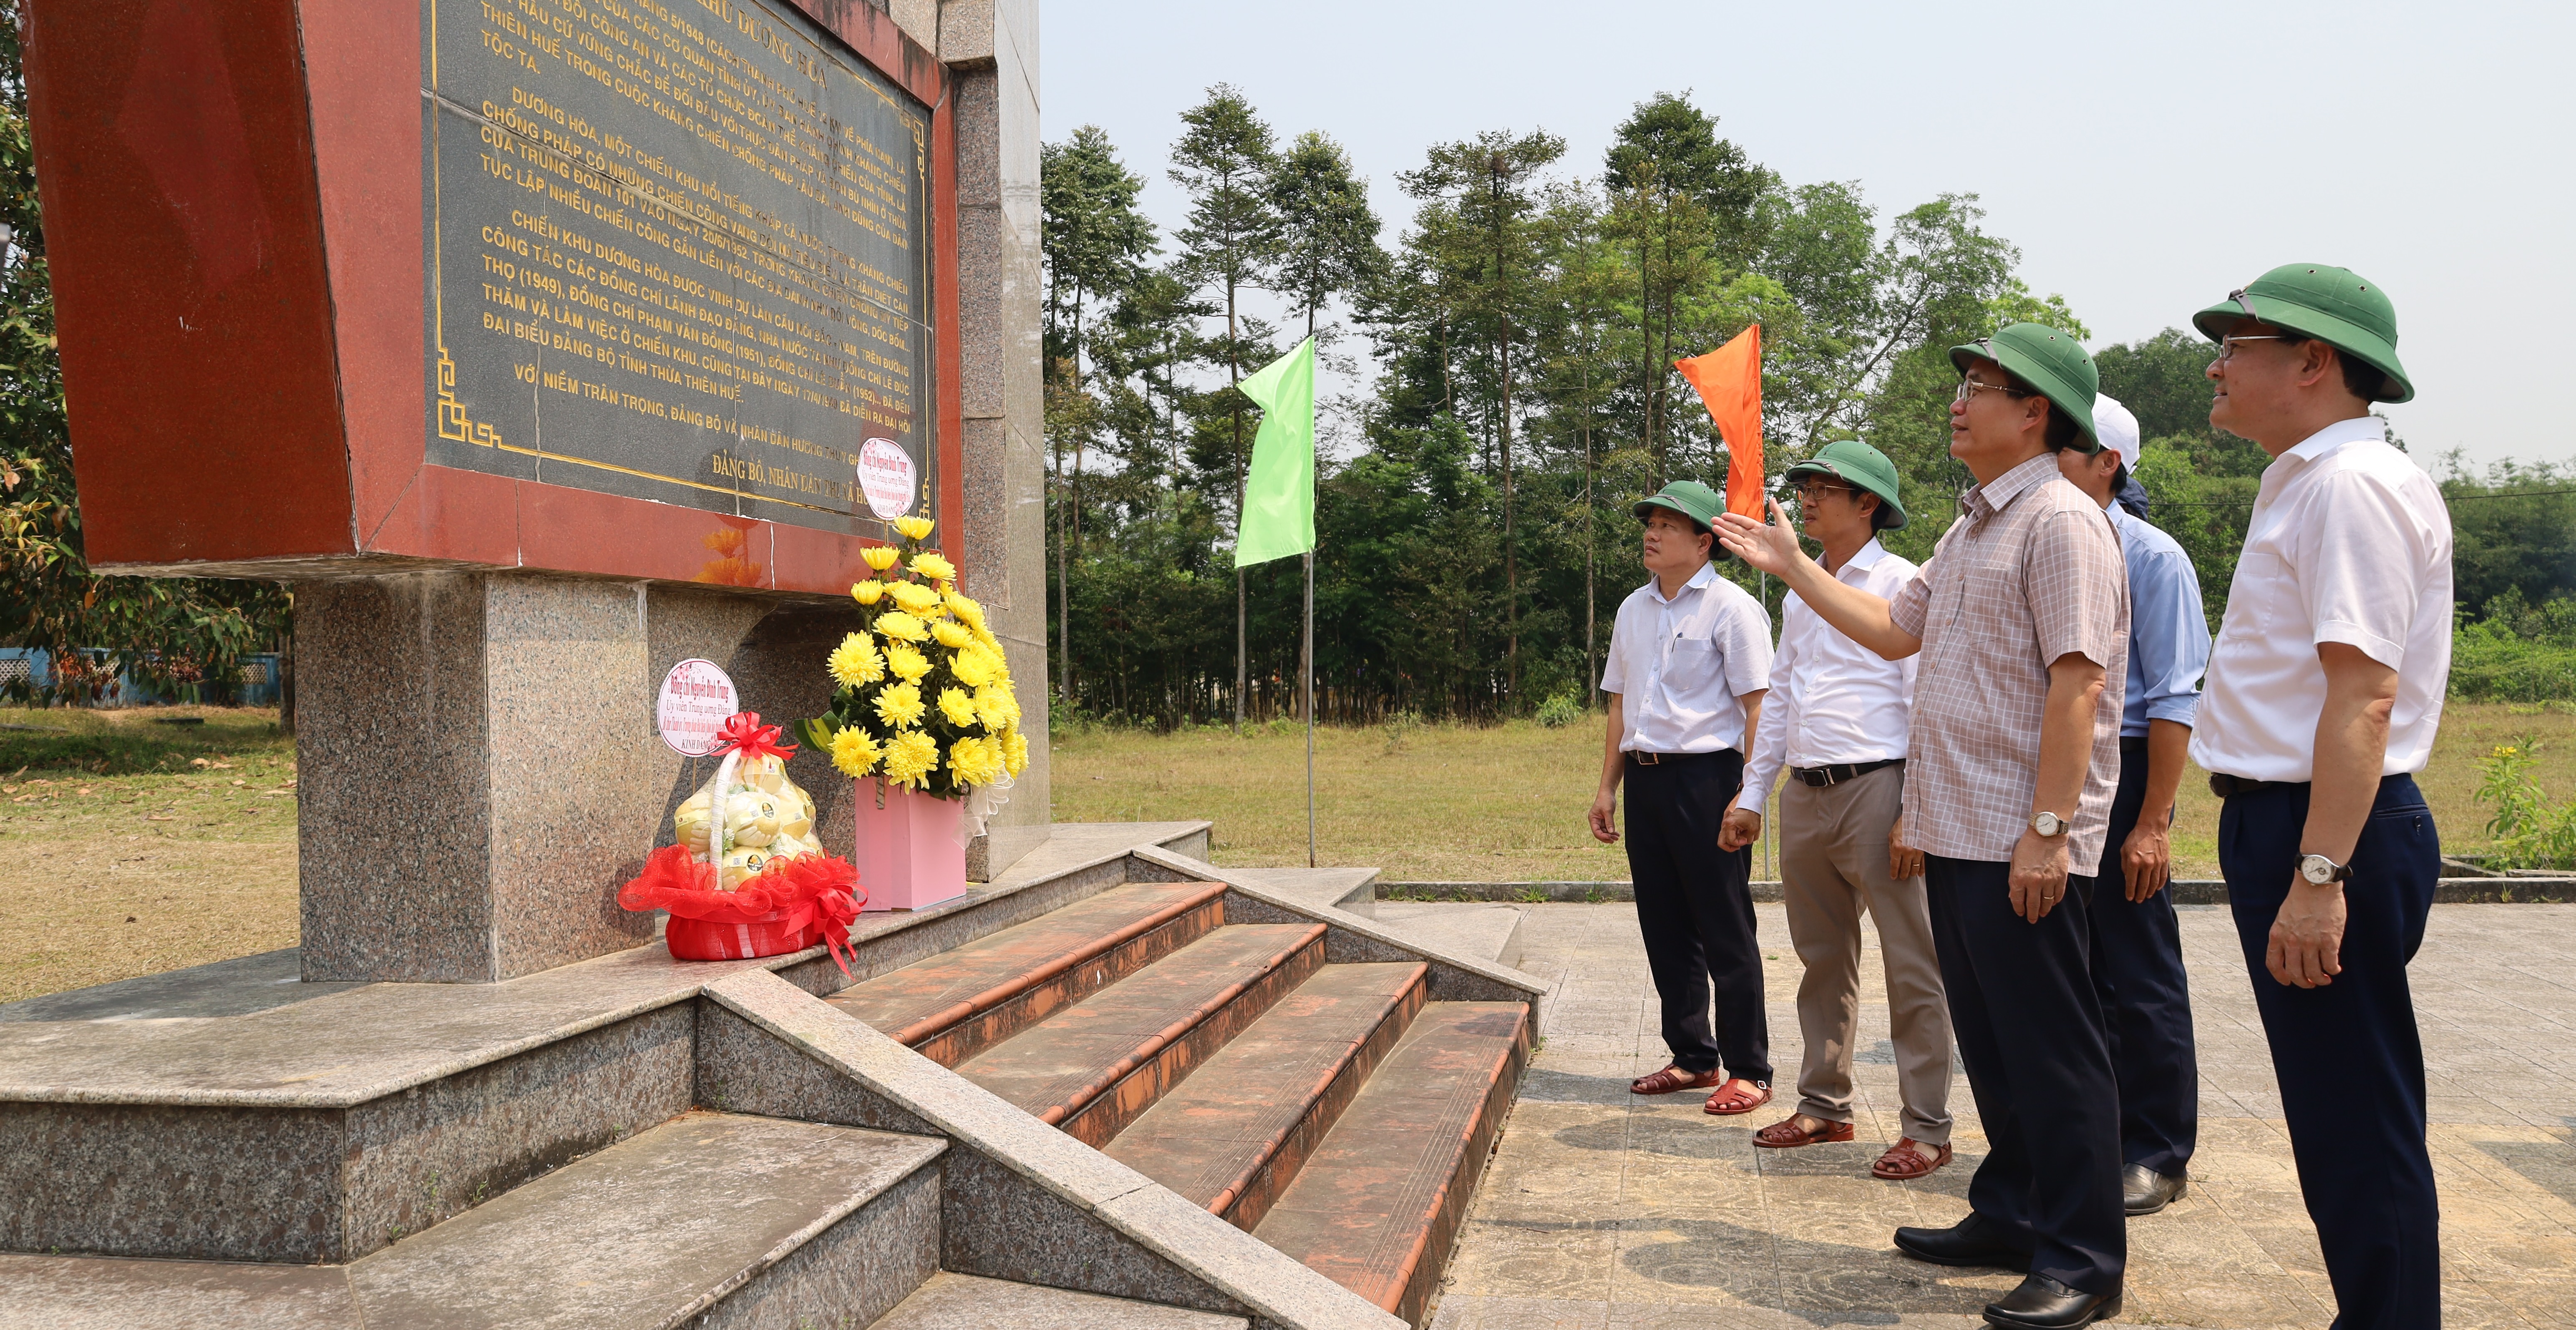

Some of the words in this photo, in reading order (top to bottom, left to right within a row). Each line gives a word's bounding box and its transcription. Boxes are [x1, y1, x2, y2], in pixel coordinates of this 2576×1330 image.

[482, 30, 513, 60] TỘC
[517, 49, 540, 75] TA.
[553, 15, 572, 40] CỨ
[577, 29, 612, 63] VỮNG
[617, 53, 651, 85] CHẮC
[655, 72, 670, 96] ĐỂ
[674, 85, 692, 108] ĐỐI
[721, 113, 738, 134] VỚI
[740, 124, 765, 151] THỰC
[849, 188, 858, 204] BÙ
[591, 11, 628, 47] CÔNG
[632, 37, 649, 59] AN
[652, 49, 668, 71] VÀ
[672, 61, 695, 87] CÁC
[699, 75, 713, 98] TỔ
[716, 88, 745, 117] CHỨC
[859, 175, 874, 194] CỦA
[633, 13, 659, 42] CÁC
[663, 31, 680, 55] CƠ
[682, 44, 713, 75] QUAN
[717, 65, 739, 91] TỈNH
[884, 171, 906, 194] CHIẾN
[671, 13, 703, 46] 5/1948
[707, 36, 738, 69] (CÁCH
[738, 9, 793, 67] DƯƠNG
[796, 50, 827, 90] HÒA
[482, 1, 527, 40] THIÊN
[532, 29, 560, 59] HUẾ
[565, 48, 611, 87] TRONG
[615, 76, 650, 108] CUỘC
[653, 98, 693, 132] KHÁNG
[697, 123, 728, 152] CHIẾN
[732, 142, 765, 172] CHỐNG
[769, 163, 793, 187] PHÁP
[852, 210, 874, 232] DŨNG
[483, 99, 538, 140] CHỐNG
[544, 128, 581, 160] PHÁP
[586, 149, 605, 171] CÓ
[609, 160, 653, 194] NHỮNG
[658, 184, 692, 213] CHIẾN
[696, 202, 728, 229] CÔNG
[730, 219, 757, 243] VANG
[513, 86, 564, 126] DƯƠNG
[569, 114, 601, 147] HÒA,
[605, 133, 632, 159] MỘT
[636, 148, 672, 179] CHIẾN
[676, 168, 699, 193] KHU
[723, 192, 752, 219] TIẾNG
[784, 223, 796, 240] CẢ
[858, 261, 884, 284] KHÁNG
[481, 153, 512, 181] TỤC
[517, 169, 544, 195] LẬP
[549, 183, 591, 215] NHIỀU
[594, 203, 632, 233] CHIẾN
[636, 221, 668, 249] CÔNG
[673, 235, 696, 261] GẮN
[699, 248, 723, 272] LIỀN
[725, 261, 741, 280] VỚI
[746, 270, 765, 290] CÁC
[785, 287, 808, 309] DANH
[512, 209, 559, 241] CHIẾN
[563, 229, 592, 254] KHU
[595, 242, 641, 273] DƯƠNG
[645, 262, 670, 284] HÒA
[673, 273, 705, 298] ĐƯỢC
[708, 287, 732, 309] VINH
[736, 298, 749, 317] DỰ
[752, 305, 772, 324] LÀM
[775, 311, 794, 333] CẦU
[861, 348, 881, 367] TRÊN
[518, 141, 569, 180] TRUNG
[616, 187, 635, 209] 101
[702, 227, 749, 261] 20/6/1952.
[752, 251, 785, 277] TRONG
[892, 314, 908, 333] TIẾP
[483, 225, 528, 257] CÔNG
[533, 244, 562, 269] TÁC
[567, 257, 595, 282] CÁC
[600, 267, 637, 297] ĐỒNG
[641, 285, 662, 306] CHÍ
[665, 294, 696, 318] LÃNH
[699, 307, 723, 328] ĐẠO
[725, 317, 756, 343] ĐẢNG,
[782, 338, 808, 359] NƯỚC
[810, 349, 821, 364] TA
[868, 371, 881, 385] CHÍ
[883, 375, 892, 390] LÊ
[483, 254, 515, 282] THỌ
[520, 267, 565, 301] (1949),
[569, 282, 609, 312] ĐỒNG
[613, 300, 634, 321] CHÍ
[638, 309, 672, 334] PHẠM
[676, 322, 698, 342] VĂN
[702, 328, 732, 354] ĐỒNG
[735, 343, 765, 368] (1951),
[483, 312, 509, 336] ĐẠI
[515, 317, 549, 346] BIỂU
[553, 332, 592, 359] ĐẢNG
[597, 346, 615, 368] BỘ
[619, 352, 647, 375] TỈNH
[651, 363, 682, 385] THỪA
[685, 373, 717, 395] THIÊN
[720, 382, 743, 403] HUẾ.
[483, 283, 526, 312] THĂM
[531, 299, 549, 319] VÀ
[554, 307, 584, 330] LÀM
[587, 317, 617, 341] VIỆC
[634, 333, 670, 357] CHIẾN
[673, 346, 698, 366] KHU.
[702, 355, 731, 377] CŨNG
[735, 366, 750, 384] TẠI
[753, 371, 771, 390] ĐÂY
[775, 379, 800, 398] NGÀY
[840, 400, 851, 415] ĐÃ
[873, 411, 882, 425] RA
[884, 415, 896, 430] ĐẠI
[899, 419, 910, 435] HỘI
[544, 368, 578, 395] NIỀM
[583, 382, 618, 405] TRÂN
[622, 392, 667, 421] TRỌNG,
[671, 404, 702, 426] ĐẢNG
[705, 414, 721, 434] BỘ
[724, 419, 737, 435] VÀ
[740, 424, 767, 443] NHÂN
[770, 431, 788, 448] DÂN
[792, 438, 821, 457] HƯƠNG
[713, 450, 745, 479] ĐẢNG
[748, 459, 765, 487] BỘ,
[768, 465, 798, 490] NHÂN
[801, 471, 821, 495] DÂN
[676, 700, 687, 712] viên
[689, 701, 703, 716] Trung
[718, 704, 730, 718] Đảng
[681, 736, 695, 749] KÍNH
[707, 679, 716, 698] Đình
[717, 680, 728, 703] Trung
